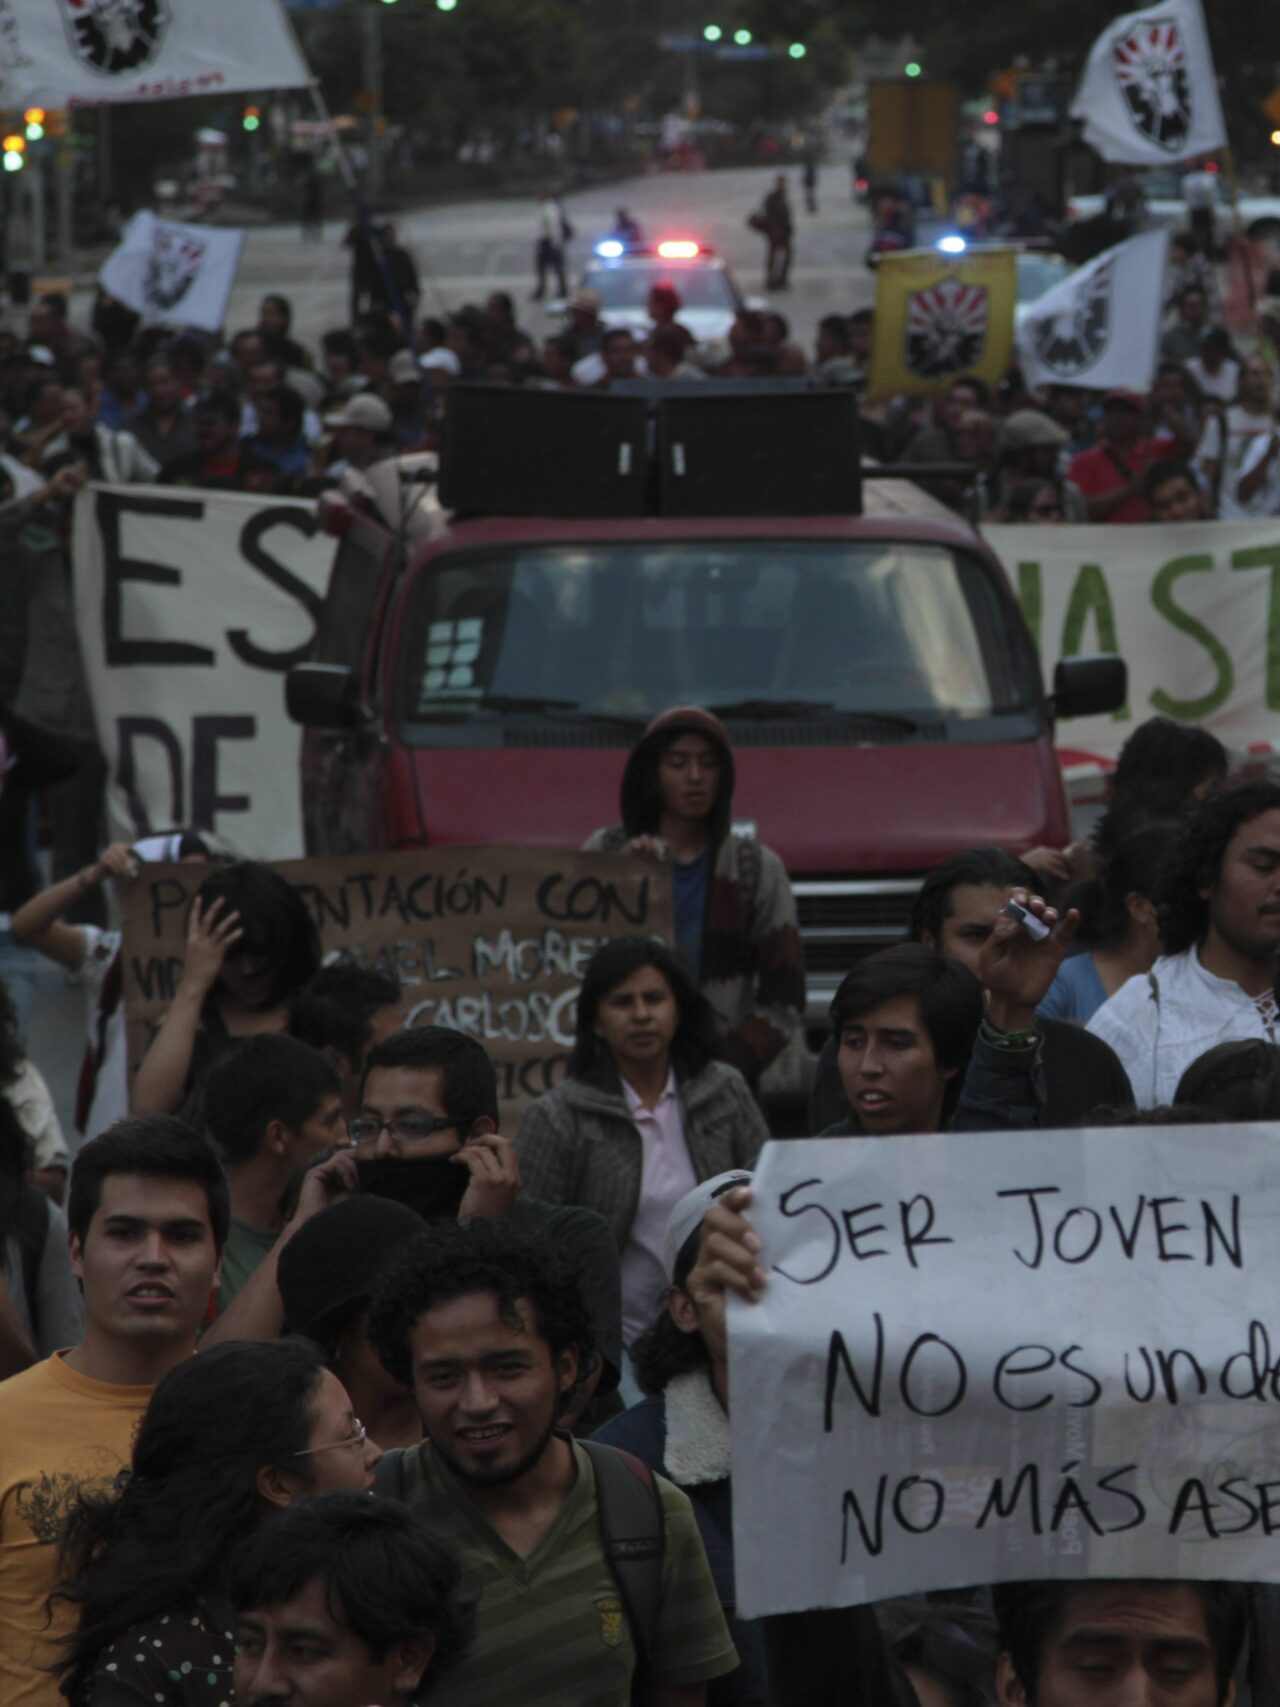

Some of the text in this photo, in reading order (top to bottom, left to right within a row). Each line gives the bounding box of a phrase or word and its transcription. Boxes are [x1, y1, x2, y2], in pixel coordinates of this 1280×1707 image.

[535, 872, 649, 926] CON
[772, 1177, 1244, 1285] SER JOVEN
[821, 1310, 970, 1434] NO
[991, 1344, 1103, 1412] es
[1123, 1345, 1208, 1405] un
[838, 1470, 947, 1566] NO
[972, 1456, 1148, 1537] MÁS
